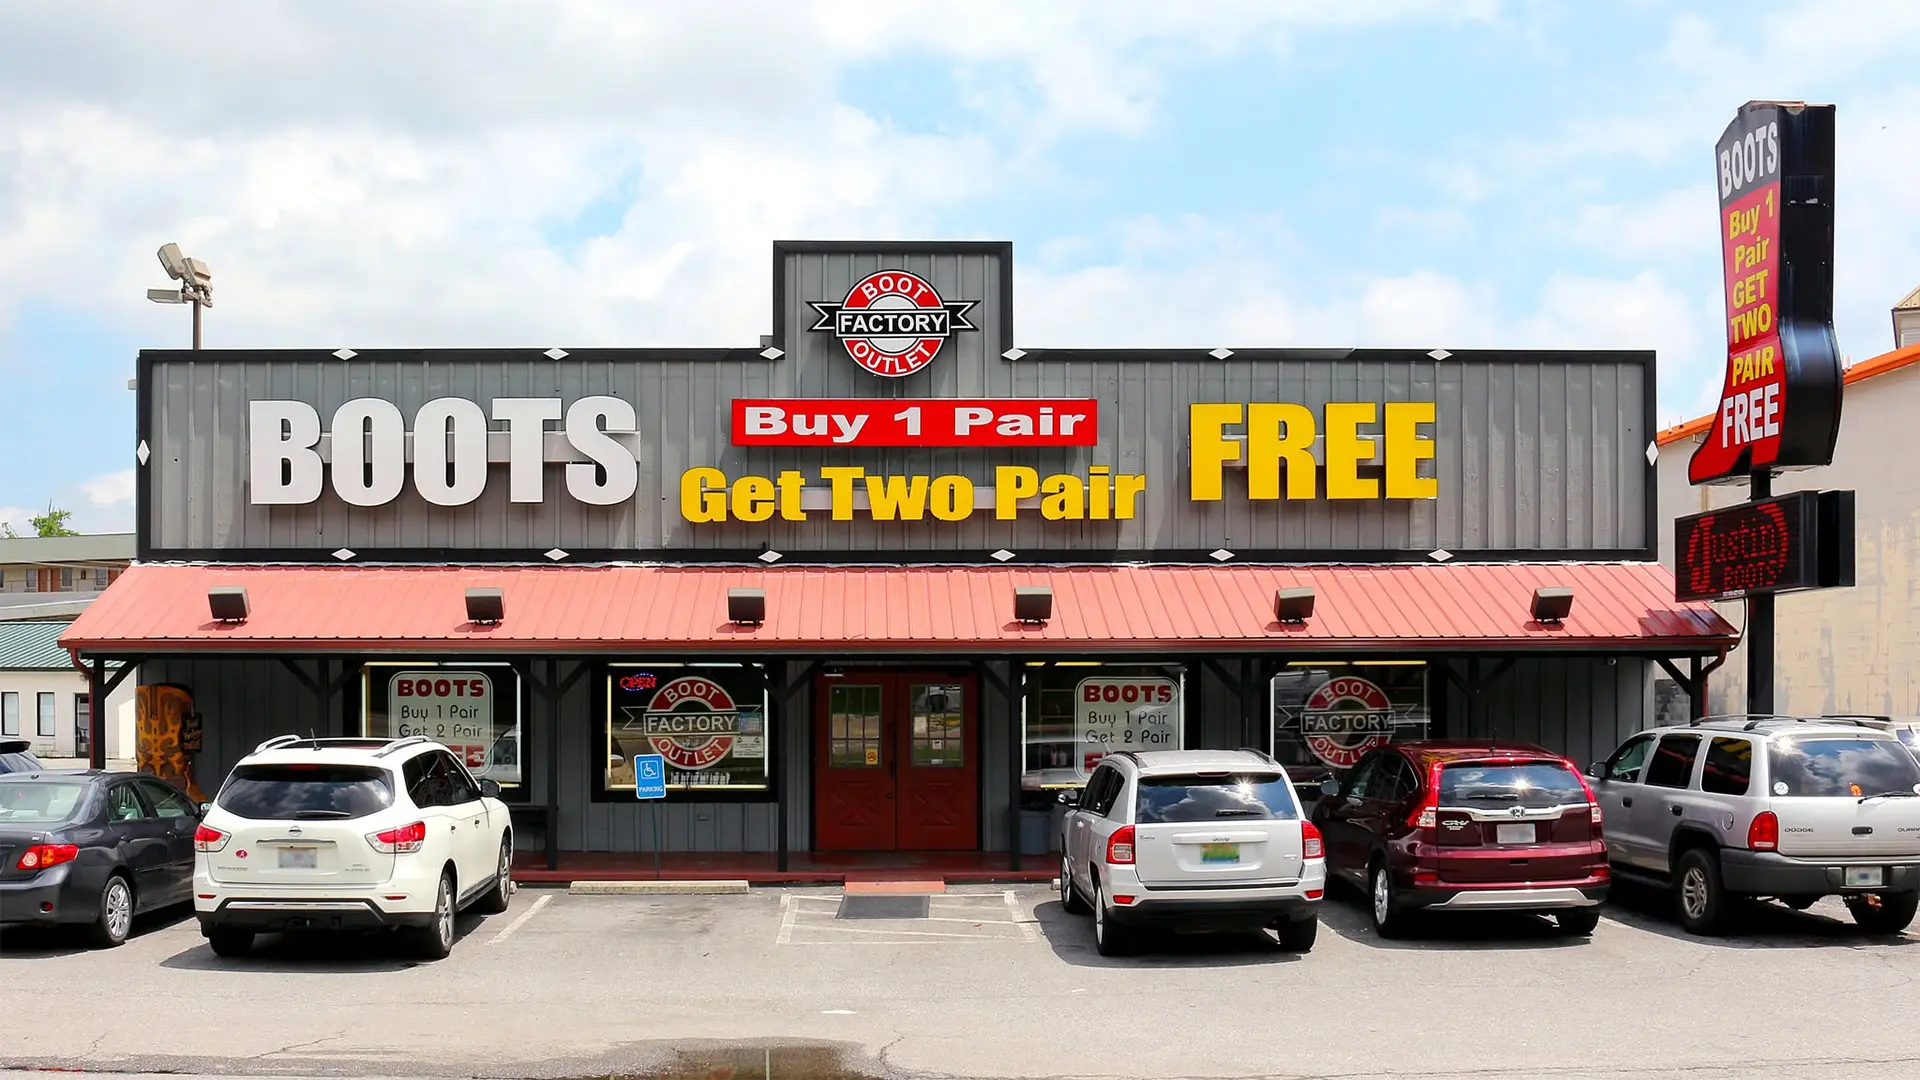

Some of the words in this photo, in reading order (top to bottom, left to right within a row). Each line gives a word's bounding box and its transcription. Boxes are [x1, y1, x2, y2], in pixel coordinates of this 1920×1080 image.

[1719, 121, 1778, 200] BOOTS
[1729, 204, 1760, 239] Buy
[1765, 188, 1774, 218] 1
[1734, 236, 1770, 273] Pair
[862, 276, 929, 302] BOOT
[1732, 270, 1769, 309] GET
[840, 314, 946, 333] FACTORY
[1731, 304, 1772, 344] TWO
[852, 340, 931, 373] OUTLET
[1731, 345, 1775, 387] PAIR
[744, 407, 869, 443] Buy
[894, 407, 923, 436] 1
[953, 407, 1087, 437] Pair
[1722, 382, 1779, 449] FREE
[249, 395, 638, 506] BOOTS
[1189, 401, 1438, 501] FREE
[680, 466, 806, 523] Get
[821, 465, 974, 522] Two
[995, 464, 1146, 521] Pair
[397, 679, 485, 697] BOOTS
[619, 676, 656, 689] OPEN
[663, 682, 720, 703] BOOT
[1083, 685, 1173, 703] BOOTS
[1321, 681, 1377, 702] BOOT
[401, 705, 428, 722] Buy
[436, 705, 442, 719] 1
[450, 705, 479, 719] Pair
[647, 715, 736, 732] FACTORY
[1088, 711, 1116, 728] Buy
[1125, 711, 1130, 724] 1
[1138, 711, 1168, 725] Pair
[1304, 714, 1391, 730] FACTORY
[398, 723, 428, 738] Get
[436, 724, 445, 738] 2
[453, 723, 483, 738] Pair
[1085, 729, 1115, 743] Get
[1123, 730, 1133, 743] 2
[1141, 730, 1171, 744] Pair
[657, 738, 725, 765] OUTLET
[1314, 737, 1377, 763] OUTLET
[638, 785, 664, 793] PARKING
